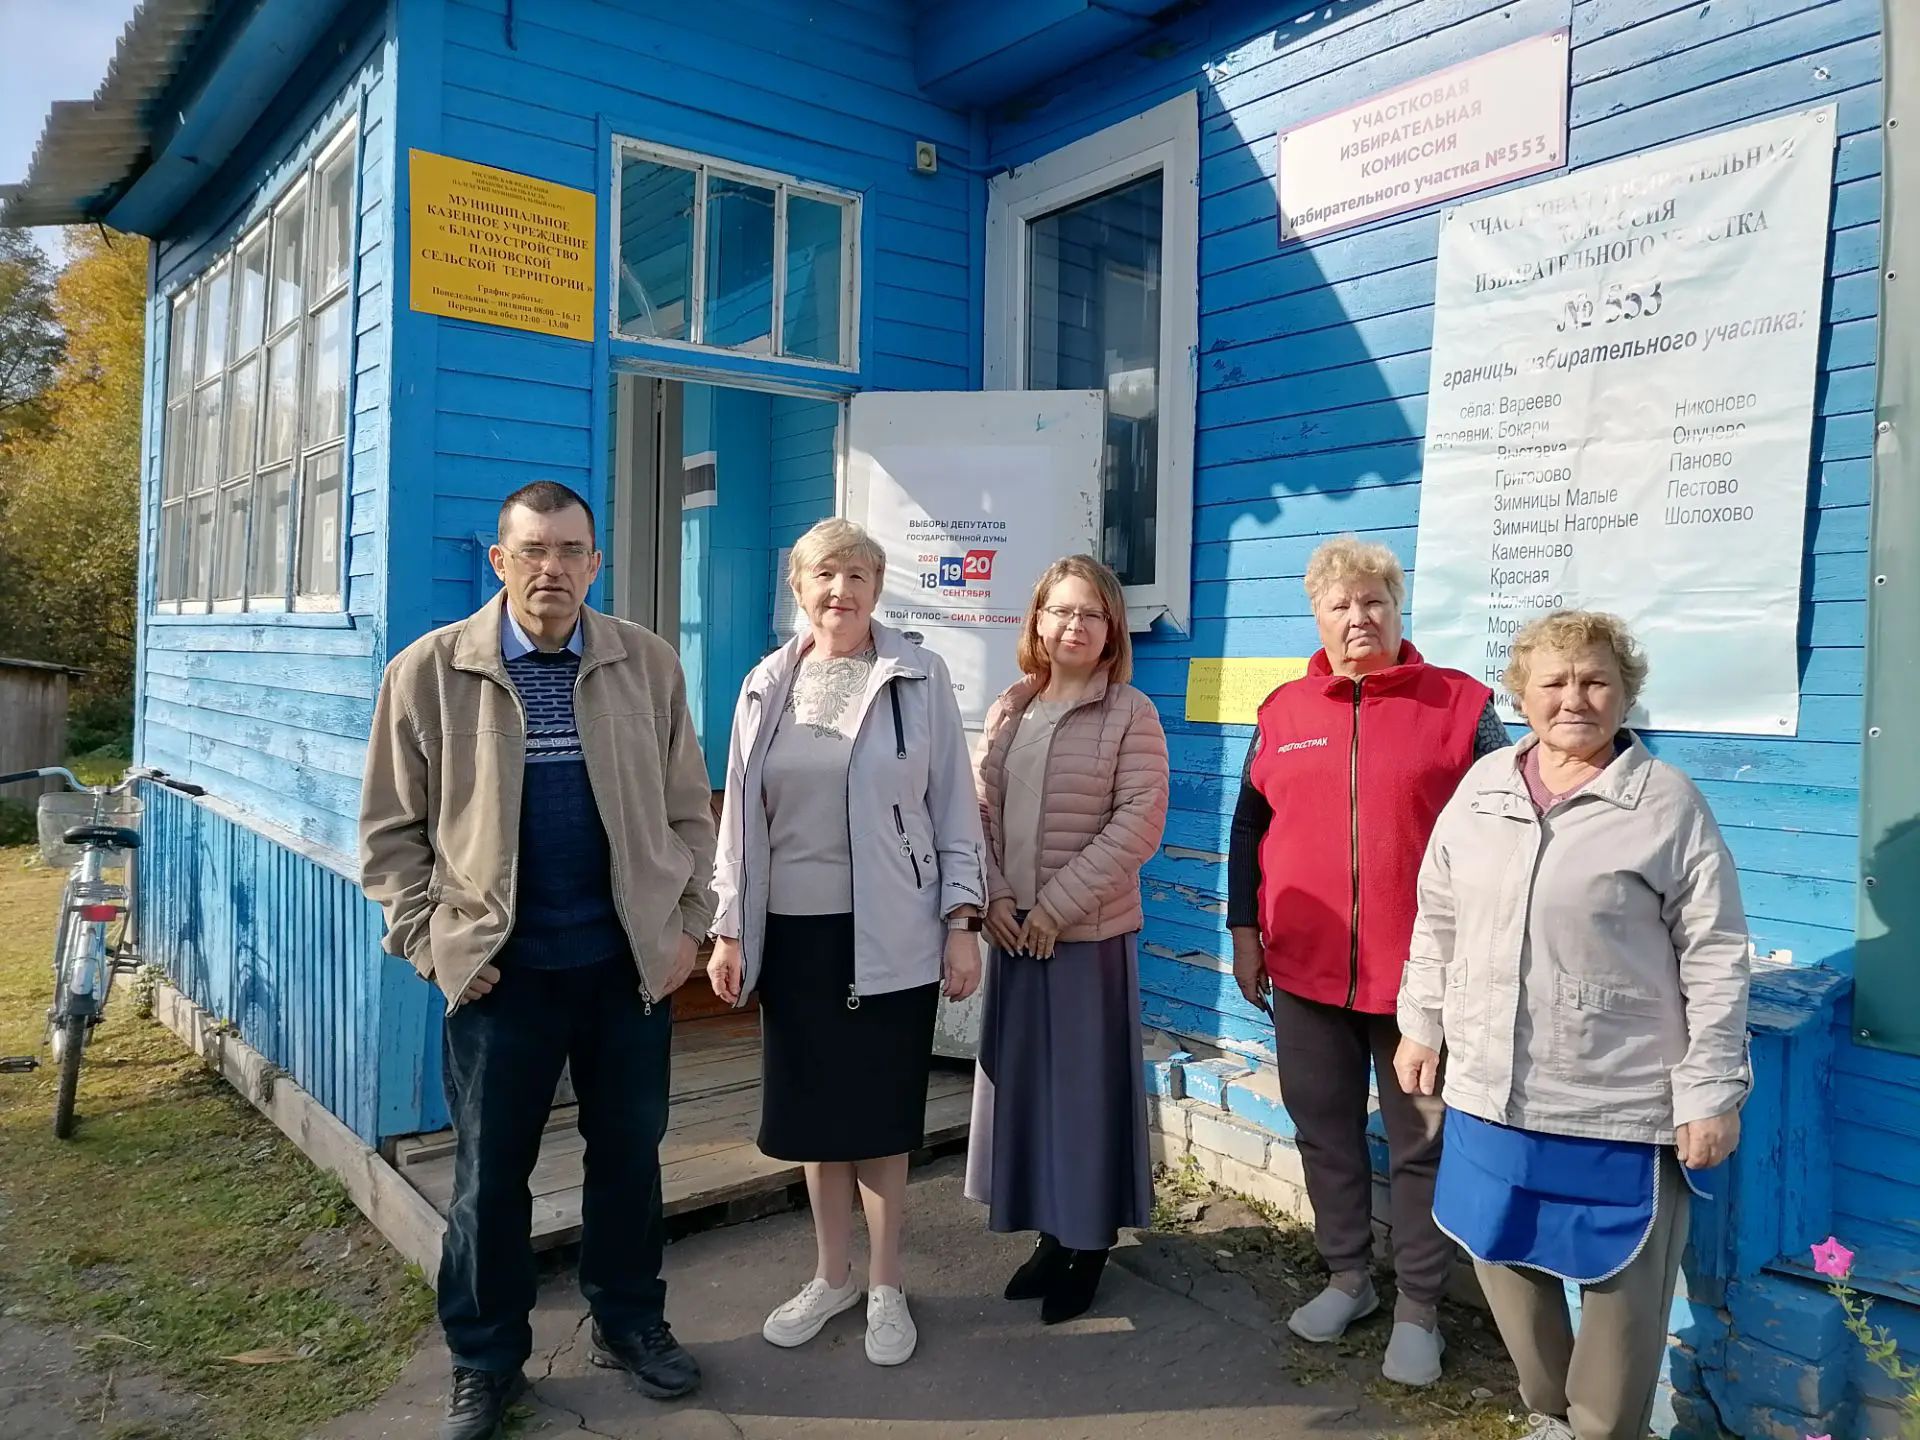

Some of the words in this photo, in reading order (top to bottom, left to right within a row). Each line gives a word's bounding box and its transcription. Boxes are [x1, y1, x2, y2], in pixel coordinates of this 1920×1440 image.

[1352, 78, 1470, 133] УЧАСТКОВАЯ
[1340, 100, 1483, 161] ИЗБИРАТЕЛЬНАЯ
[1361, 133, 1458, 178] КОМИССИЯ
[1290, 179, 1410, 229] избирательного
[1415, 160, 1480, 194] участка
[449, 194, 570, 231] МУНИЦИПАЛЬНОЕ
[1469, 191, 1592, 236] УЧАСТОВАЯ
[1558, 198, 1677, 245] КОМССИЯ
[427, 204, 500, 229] КАЗЕННОЕ
[503, 221, 589, 250] УЧРЕЖДЕНИЕ
[1661, 209, 1768, 243] СТКА
[449, 224, 579, 262] БЛАГОУСТРОЙСТВО
[421, 248, 496, 273] СЕЛЬСКОЙ
[469, 243, 551, 270] ПАНОВСКОЙ
[432, 287, 490, 304] Понедельник
[497, 300, 532, 313] пятница
[534, 305, 554, 317] 08:00
[561, 310, 581, 322] 16.12
[477, 284, 510, 298] График
[511, 291, 544, 304] работы:
[448, 301, 486, 316] Перерыв
[500, 311, 518, 321] обед
[520, 314, 541, 325] 12:00
[1701, 309, 1806, 352] участка:
[1499, 392, 1562, 416] Вареево
[1675, 393, 1757, 418] Никоново
[1498, 420, 1550, 440] Бокари
[1669, 450, 1732, 472] Паново
[1494, 493, 1560, 512] Зимницы
[1565, 488, 1618, 506] Малые
[1667, 477, 1739, 499] Пестово
[909, 520, 949, 529] ВЫБОРЫ
[950, 520, 1006, 530] ДЕПУТАТОВ
[1492, 516, 1559, 537] Зимницы
[1564, 511, 1639, 533] Нагорные
[1664, 504, 1754, 527] Шолохово
[906, 533, 981, 543] ГОСУДАРСТВЕННОЙ
[982, 534, 1007, 543] ДУМЫ
[918, 554, 939, 562] 2026
[1491, 541, 1574, 561] Каменново
[919, 573, 938, 589] 18
[942, 563, 962, 581] 19
[965, 556, 990, 574] 20
[1490, 567, 1550, 588] Красная
[942, 588, 991, 598] СЕНТЯБРЯ
[885, 610, 909, 620] ТВОЙ
[910, 611, 941, 621] ГОЛОС
[951, 612, 976, 622] СИЛА
[978, 614, 1021, 624] РОССИИ!
